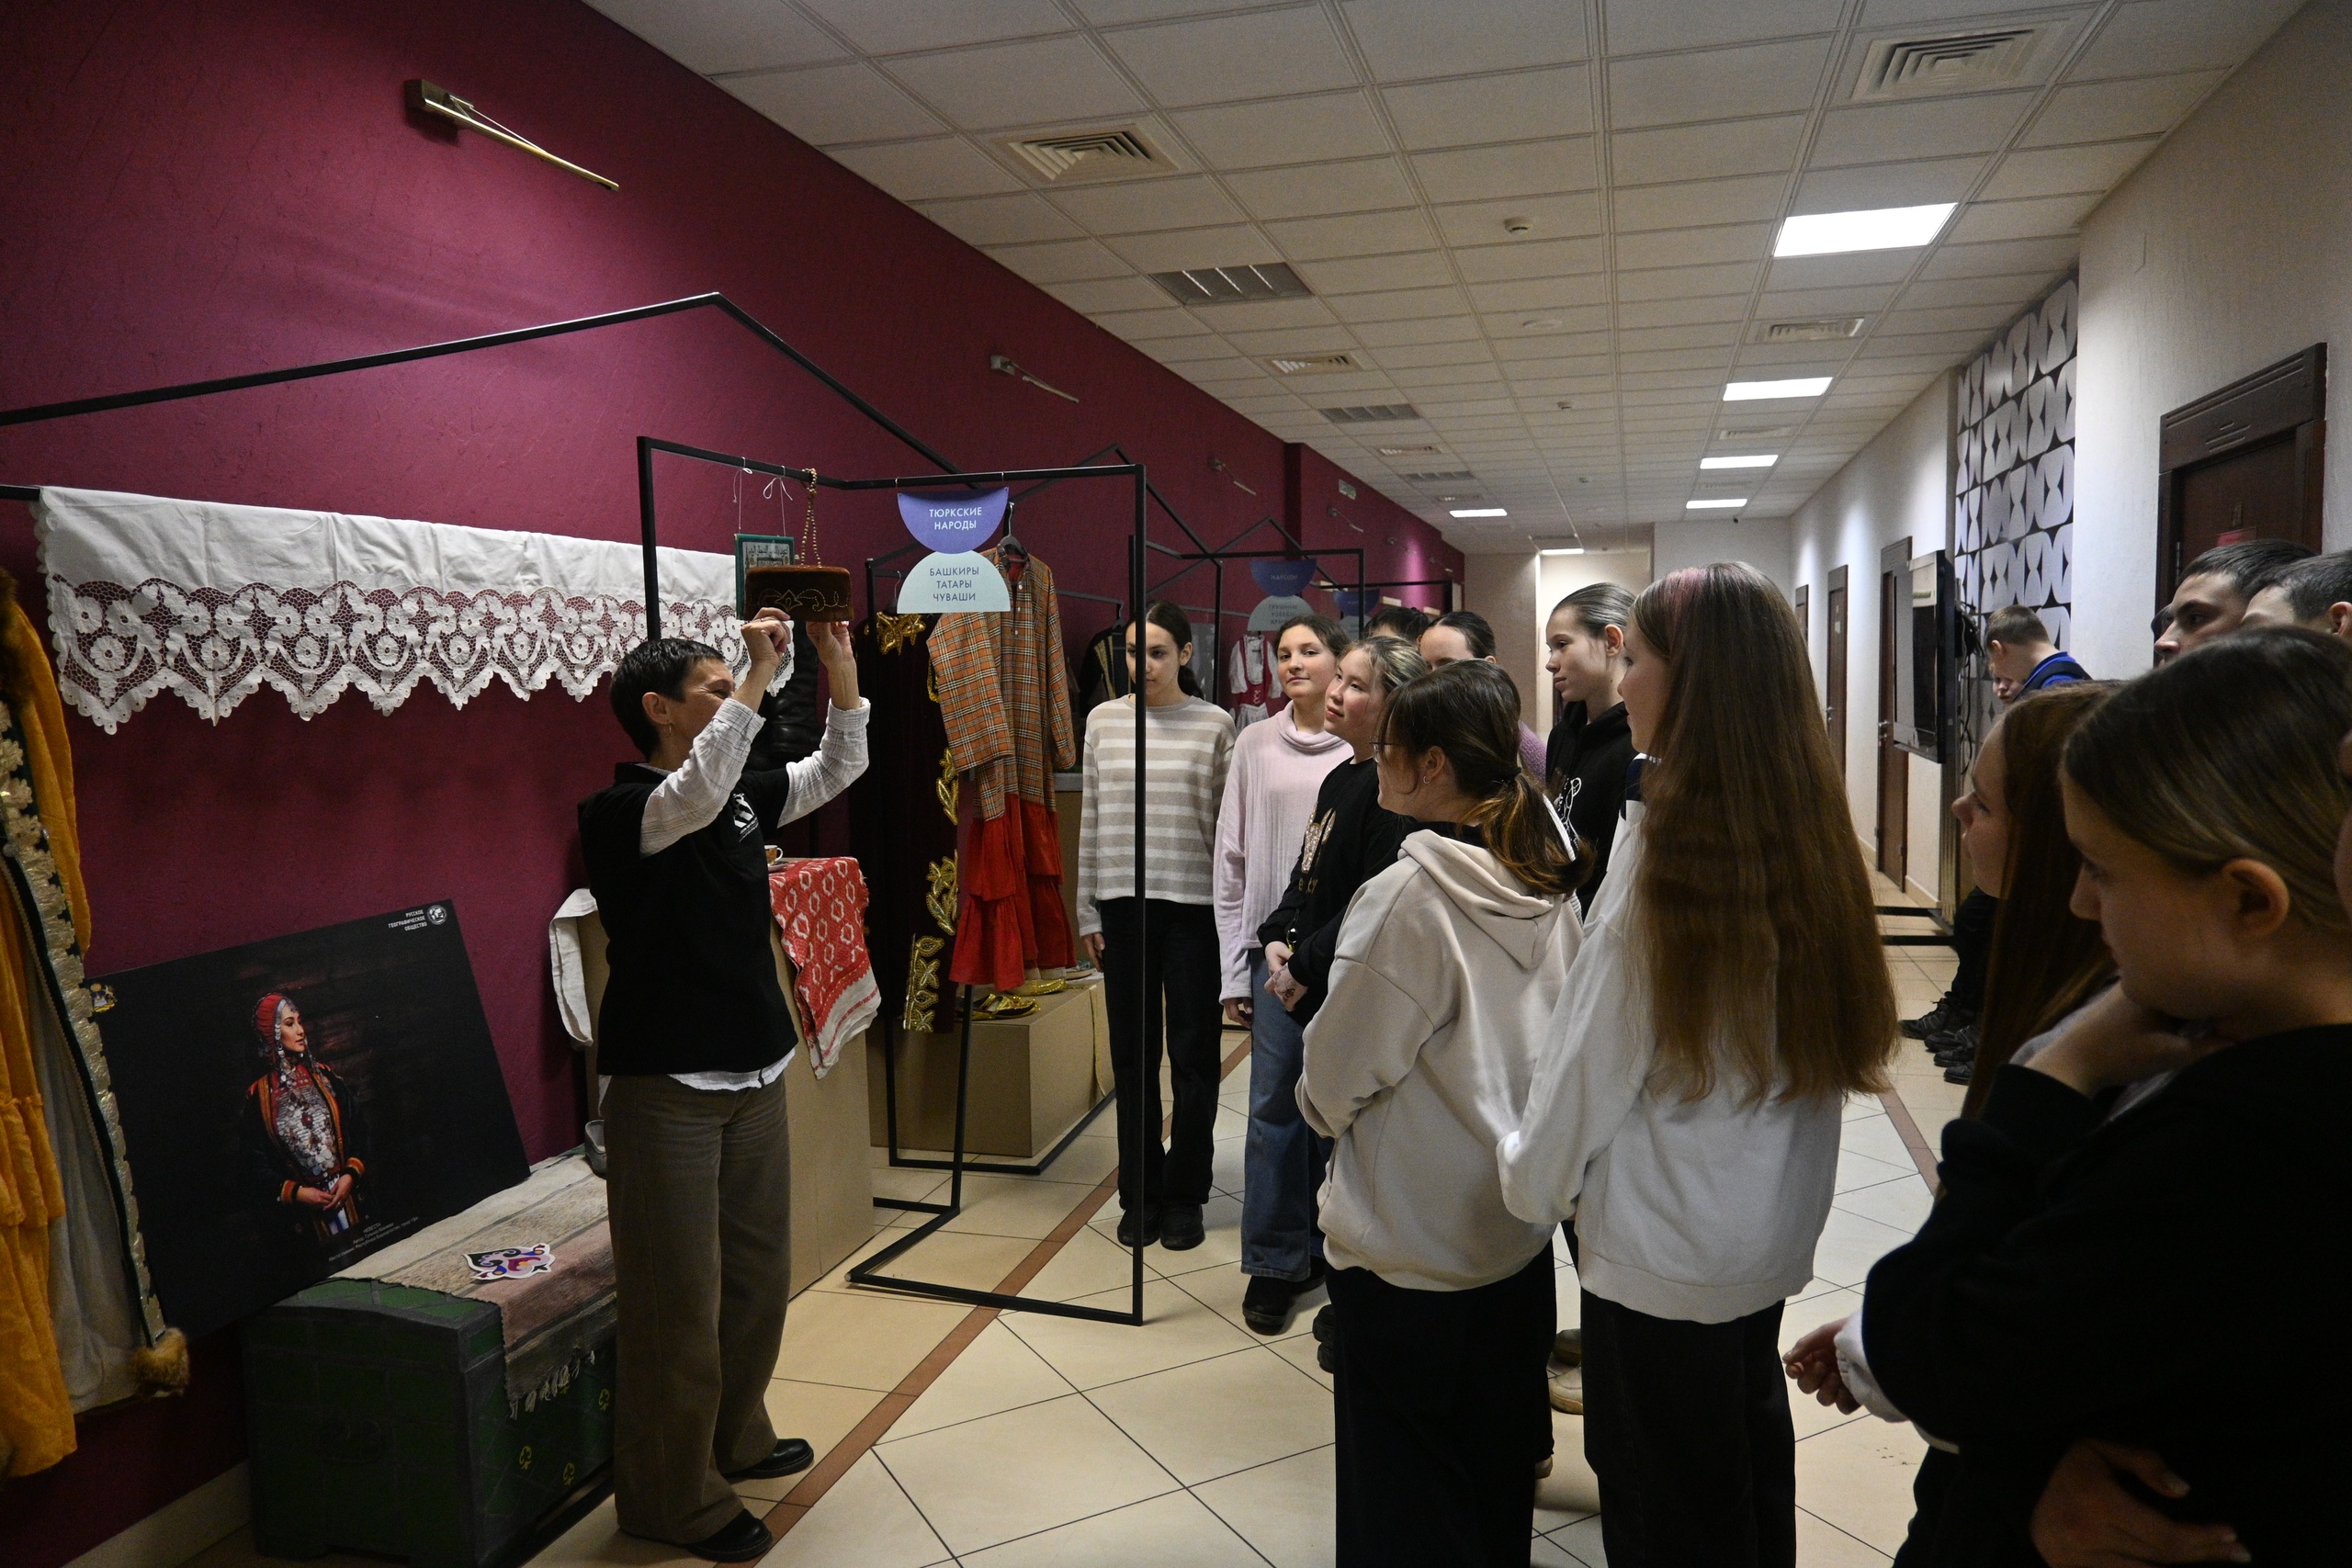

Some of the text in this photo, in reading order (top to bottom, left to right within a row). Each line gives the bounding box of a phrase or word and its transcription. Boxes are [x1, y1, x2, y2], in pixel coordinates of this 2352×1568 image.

[929, 507, 982, 518] ТЮРКСКИЕ
[934, 520, 977, 531] НАРОДЫ
[929, 567, 979, 576] БАШКИРЫ
[937, 580, 972, 589] ТАТАРЫ
[933, 592, 976, 602] ЧУВАШИ
[405, 909, 424, 918] РУССКОЕ
[388, 916, 425, 929] ГЕОГРАФИЧЕСКОЕ
[404, 921, 427, 931] ОБЩЕСТВО
